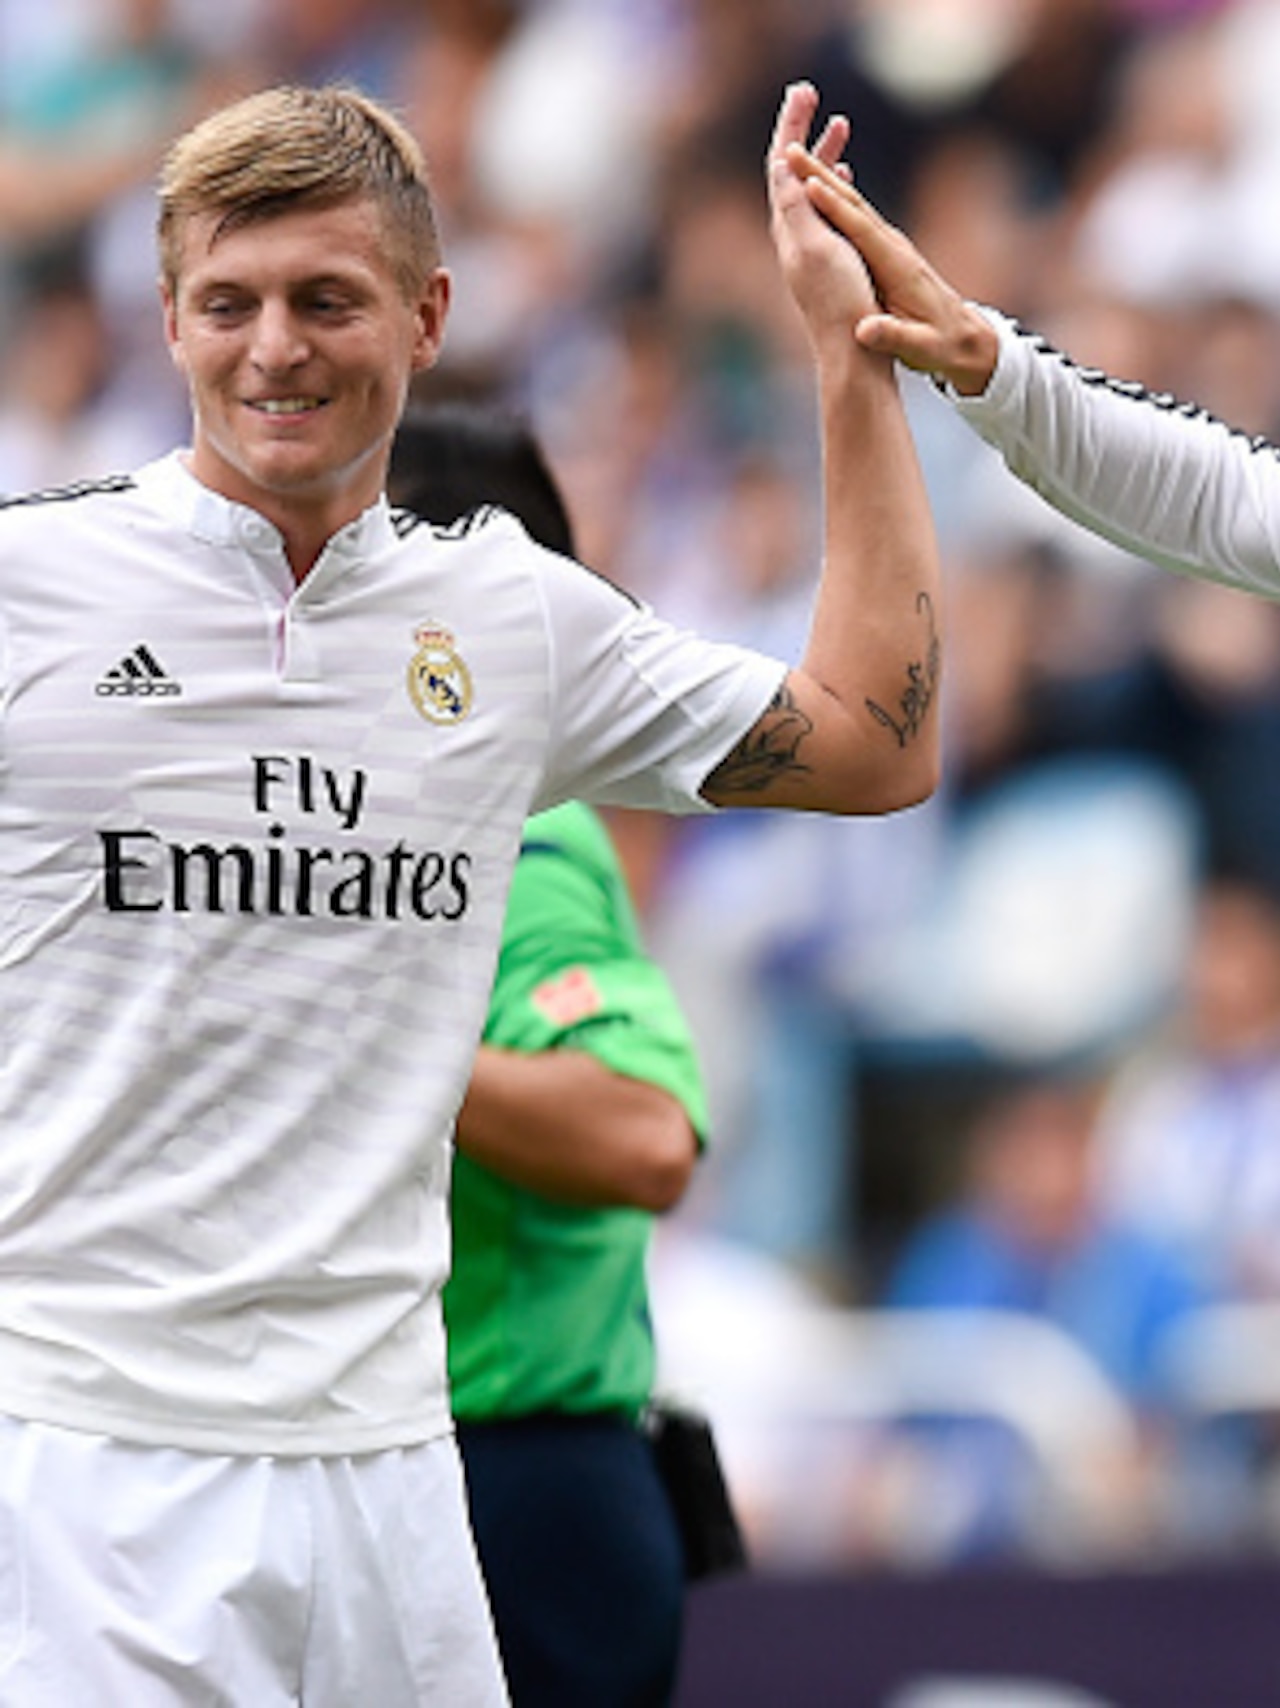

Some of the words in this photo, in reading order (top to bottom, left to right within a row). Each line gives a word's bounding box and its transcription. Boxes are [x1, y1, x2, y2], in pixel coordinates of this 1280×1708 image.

[96, 679, 181, 696] adidas
[253, 756, 366, 829] Fly
[98, 824, 470, 920] Emirates
